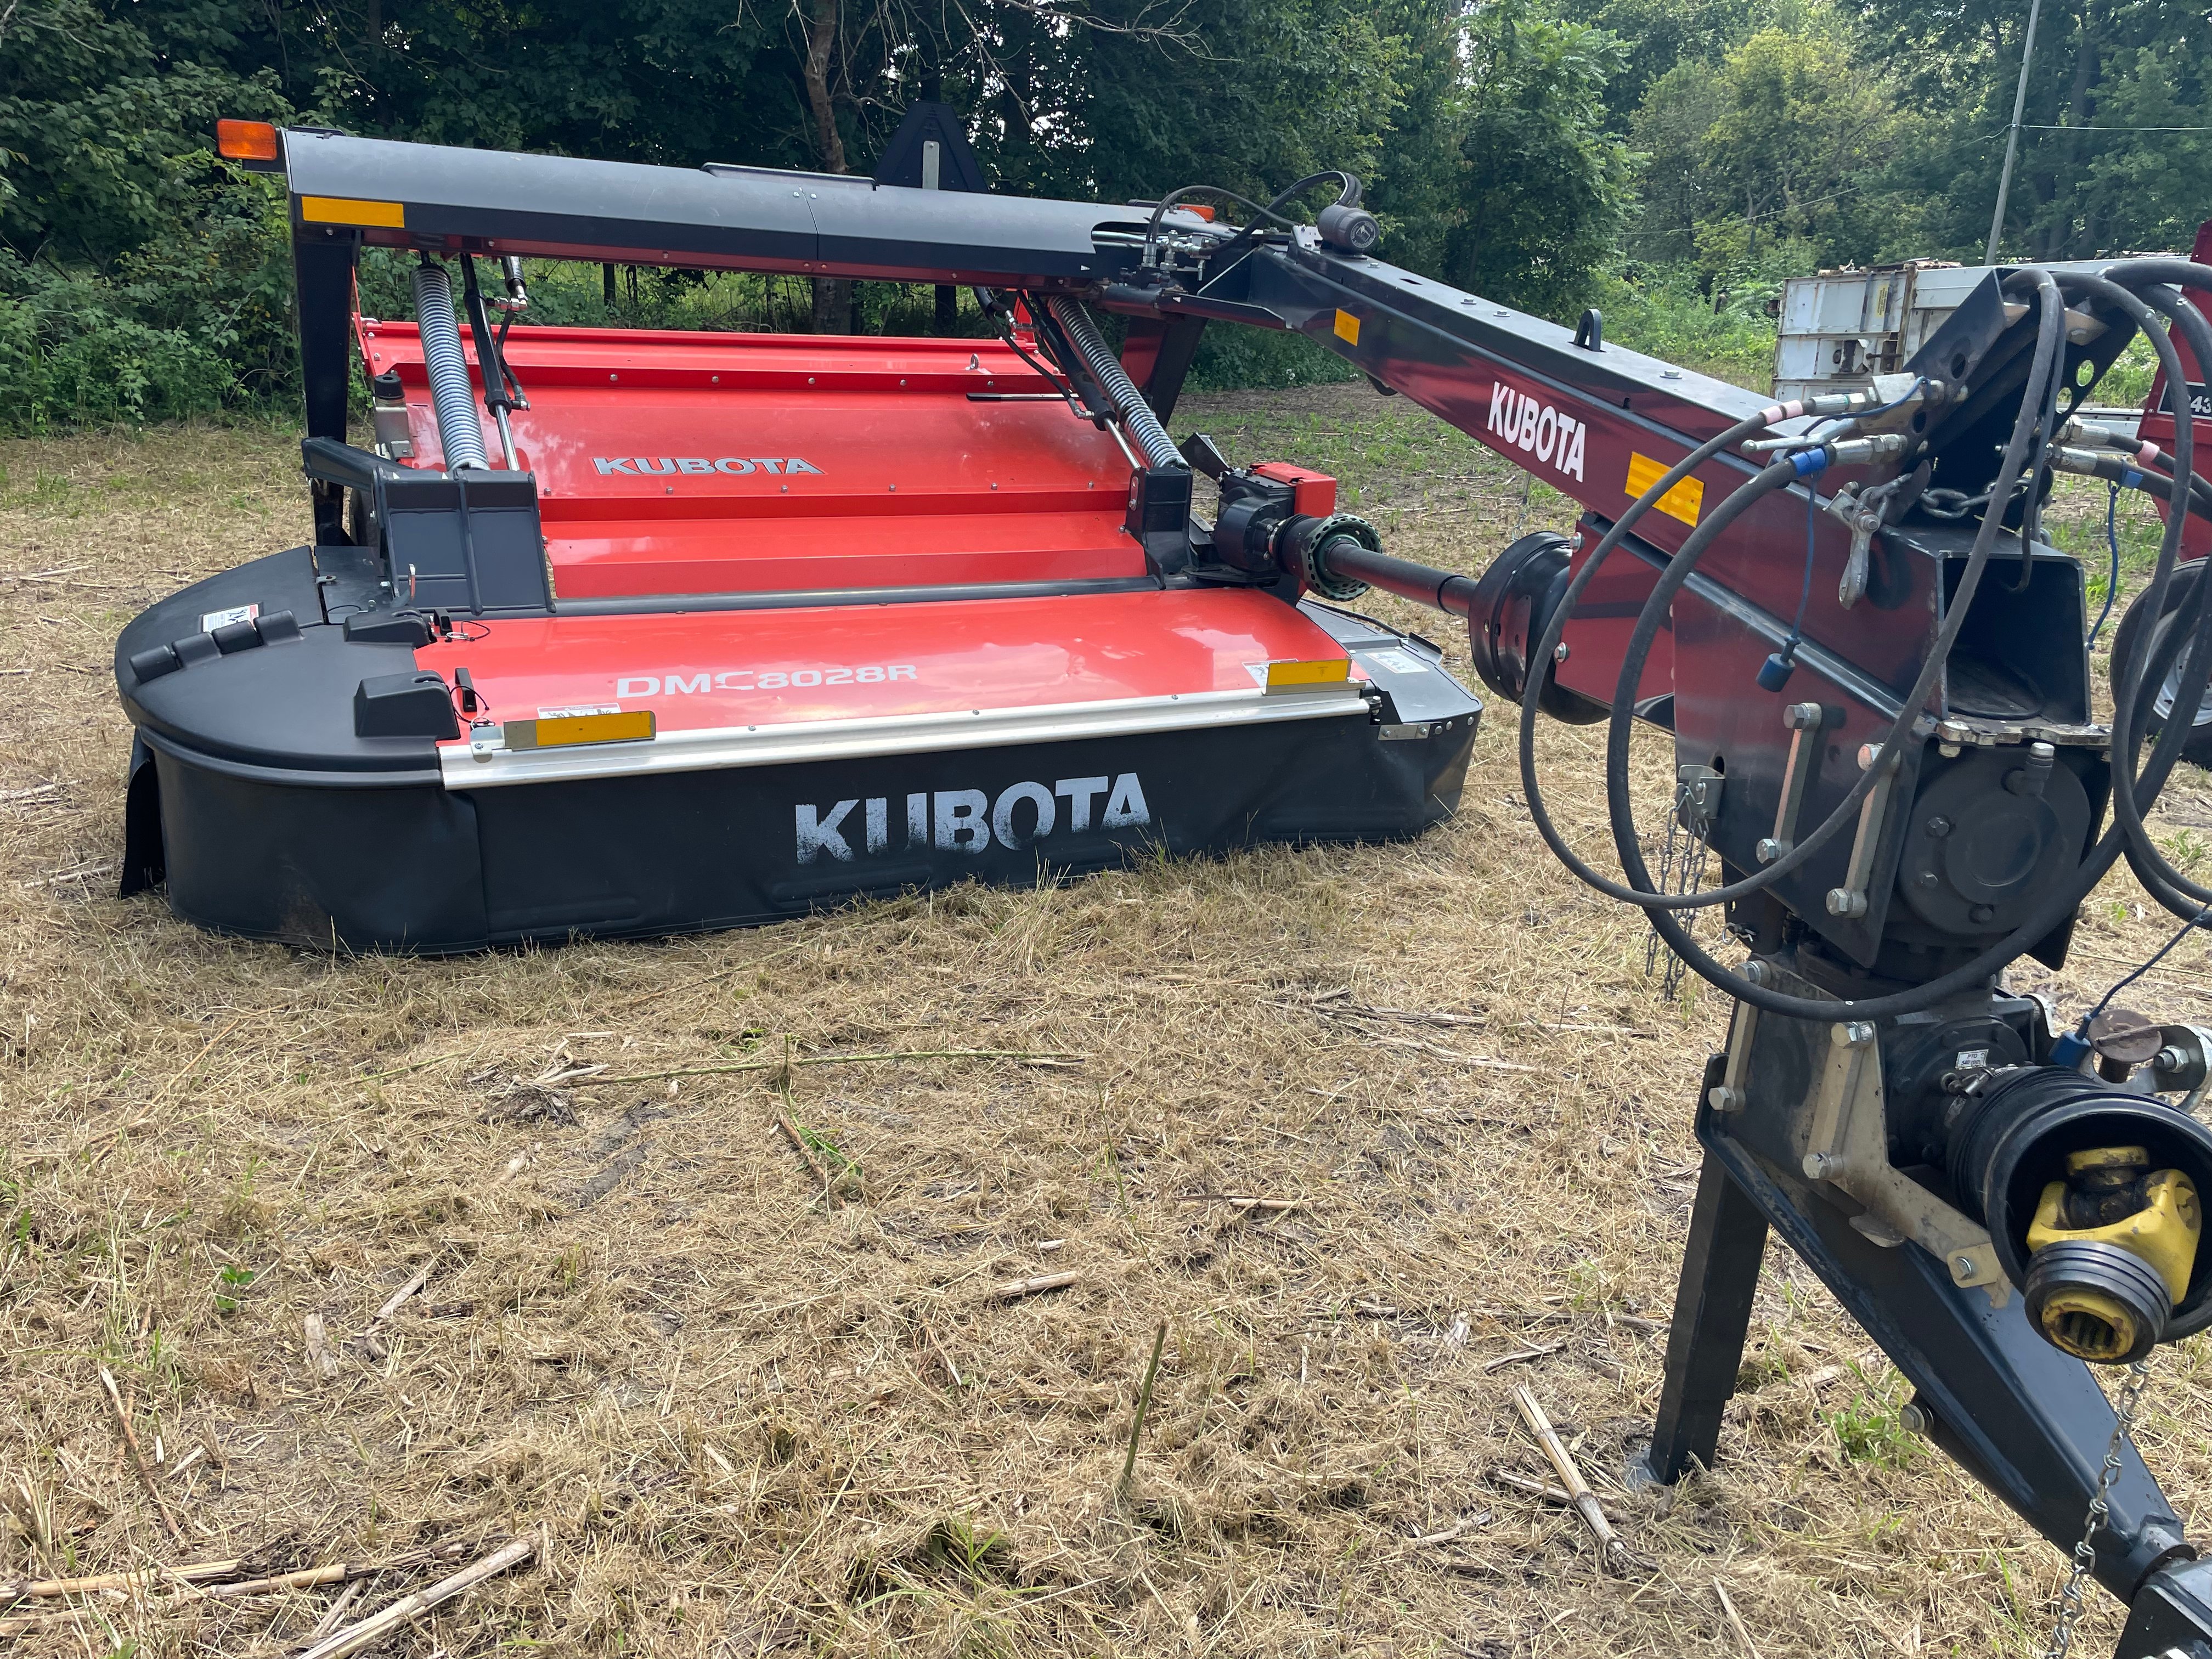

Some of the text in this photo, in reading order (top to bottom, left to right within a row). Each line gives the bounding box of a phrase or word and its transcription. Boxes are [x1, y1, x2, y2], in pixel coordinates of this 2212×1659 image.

[1487, 381, 1587, 483] KUBOTA
[592, 457, 826, 476] KUBOTA
[617, 664, 918, 698] DMC8028R
[795, 772, 1151, 865] KUBOTA
